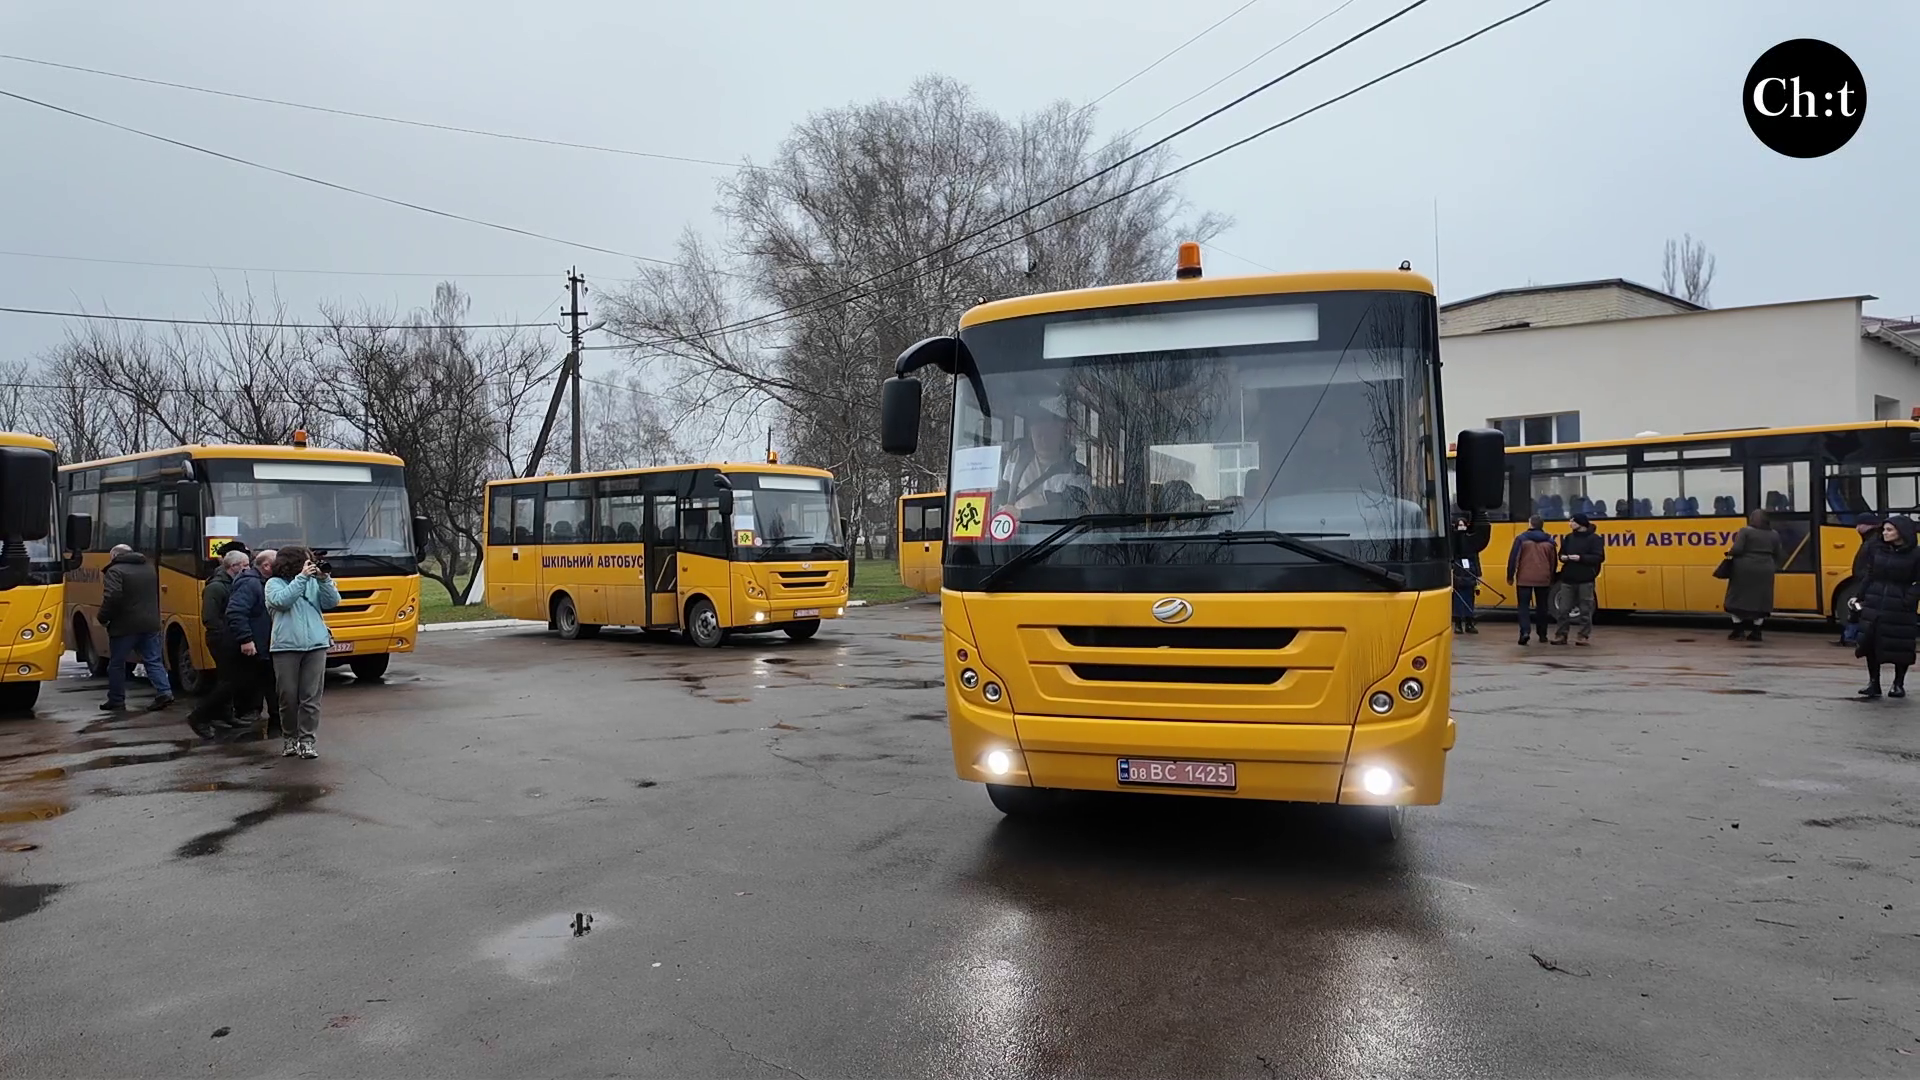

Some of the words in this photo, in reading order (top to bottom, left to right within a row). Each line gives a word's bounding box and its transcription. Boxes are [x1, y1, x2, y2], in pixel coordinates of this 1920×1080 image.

[994, 520, 1011, 534] 70
[542, 553, 594, 568] ШКІЛЬНИЙ
[597, 555, 644, 568] АВТОБУС
[1130, 767, 1147, 780] 08
[1185, 765, 1228, 783] 1425
